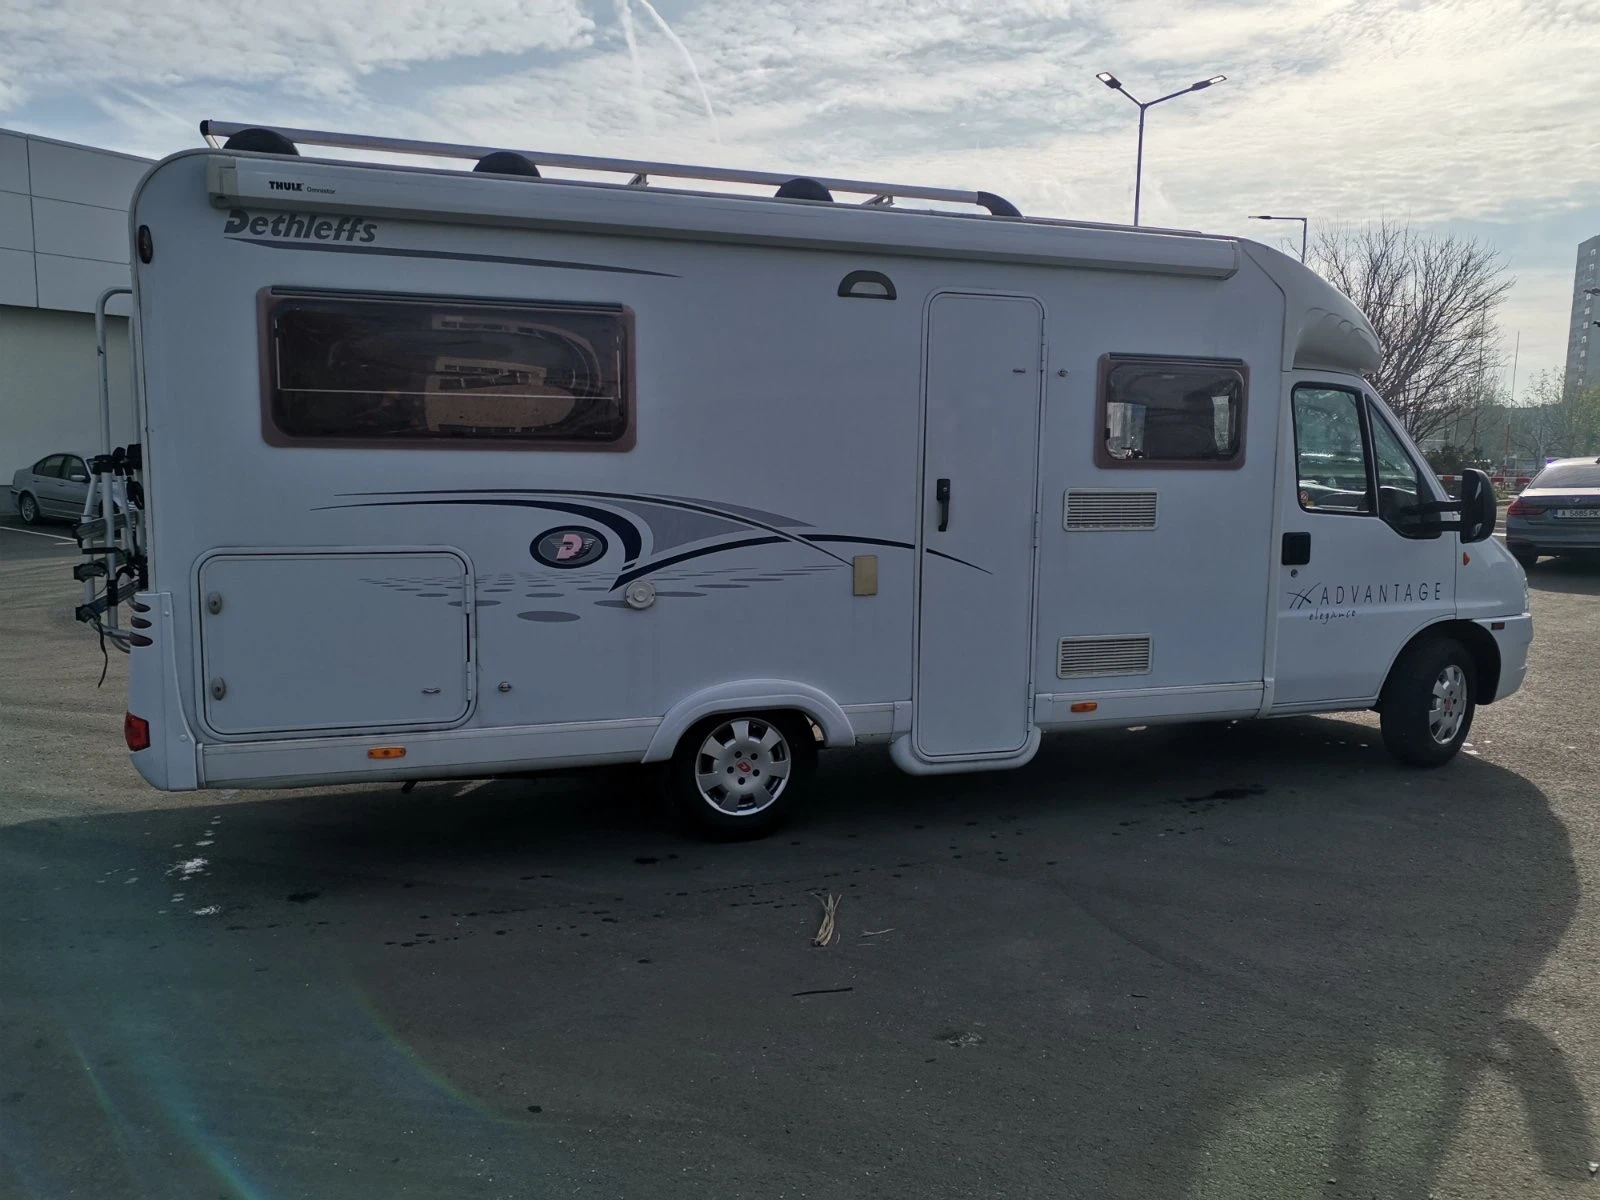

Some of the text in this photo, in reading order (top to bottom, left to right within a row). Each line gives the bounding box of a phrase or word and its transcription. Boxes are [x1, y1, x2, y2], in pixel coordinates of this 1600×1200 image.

[268, 181, 302, 191] THULE
[224, 209, 377, 242] Dethleffs
[1320, 582, 1441, 605] ADVANTAGE
[1308, 608, 1356, 624] elegance
